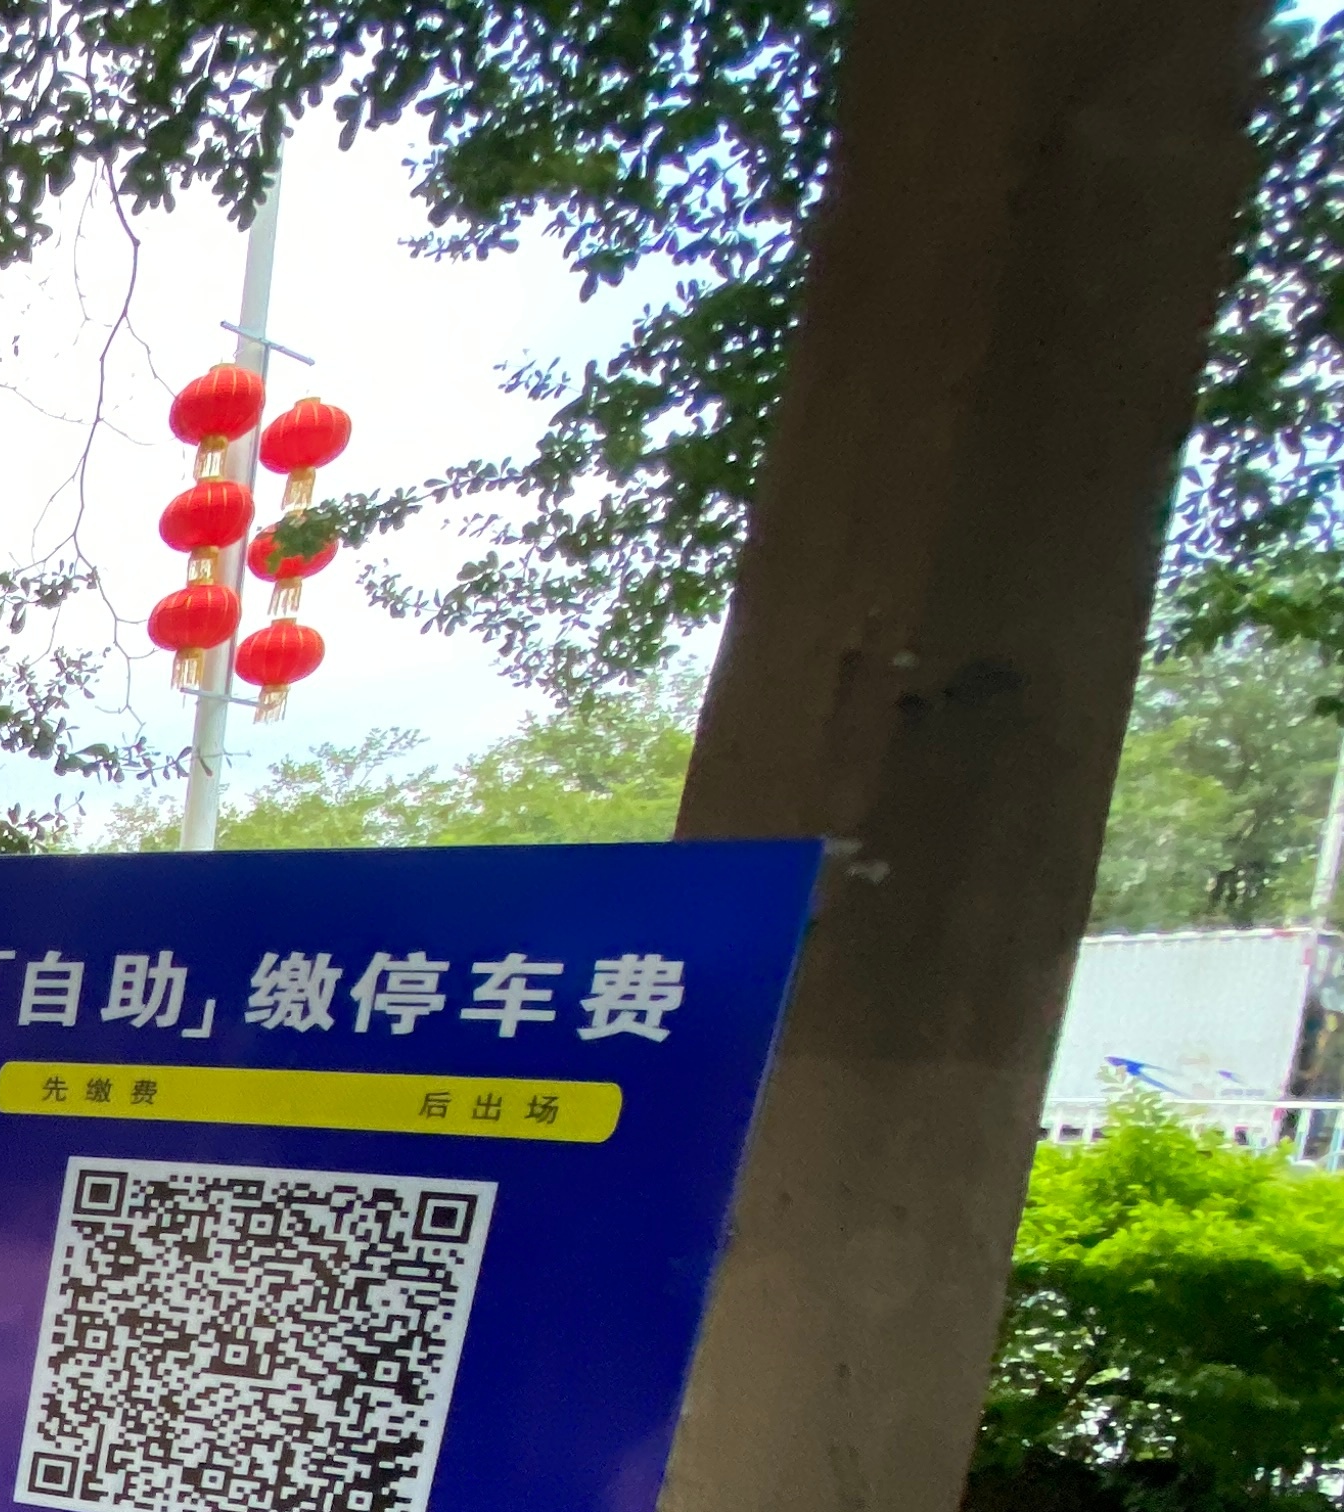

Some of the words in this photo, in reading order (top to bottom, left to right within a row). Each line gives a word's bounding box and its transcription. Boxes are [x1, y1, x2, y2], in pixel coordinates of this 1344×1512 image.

[41, 1076, 159, 1105] 先缴费
[418, 1091, 560, 1126] 后出场
